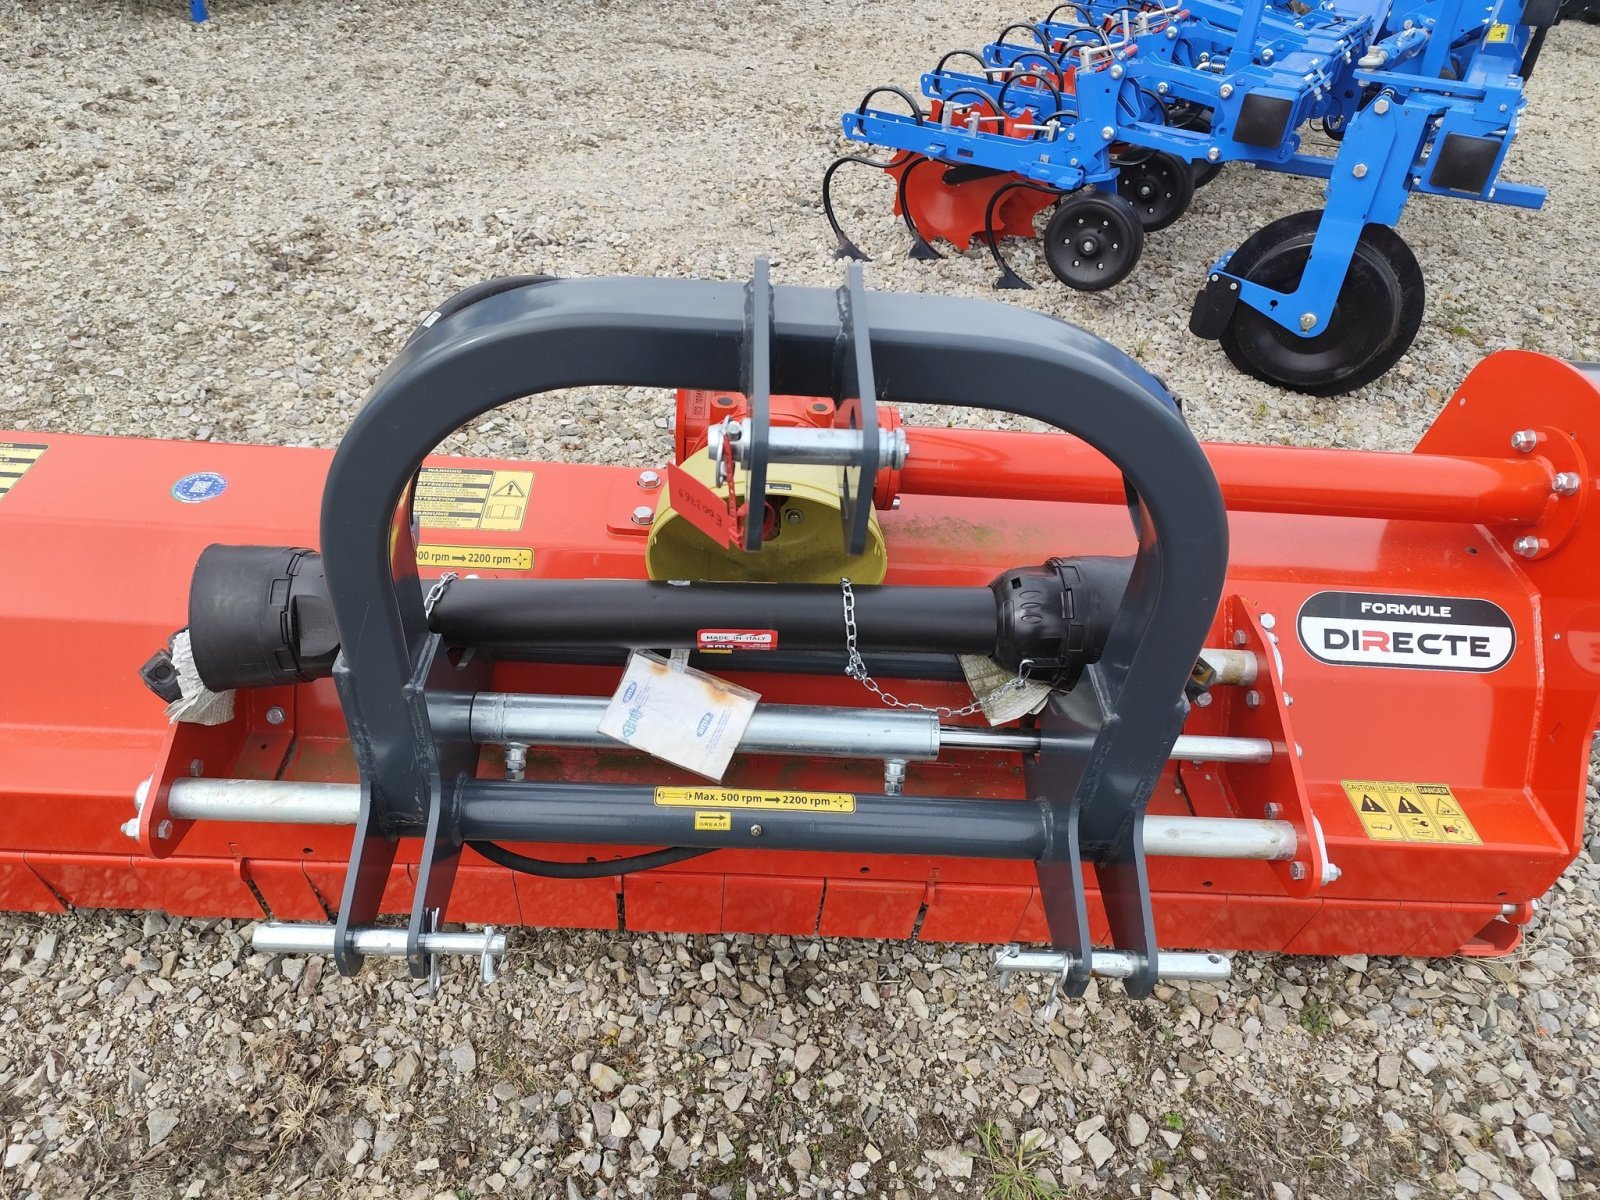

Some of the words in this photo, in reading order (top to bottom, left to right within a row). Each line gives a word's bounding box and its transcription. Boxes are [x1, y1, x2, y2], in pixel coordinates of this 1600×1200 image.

[431, 553, 450, 563] rpm
[468, 553, 490, 563] 2200
[492, 555, 511, 565] rpm
[1361, 602, 1452, 618] FORMULE
[1323, 628, 1491, 658] DIRECTE
[1417, 786, 1449, 794] DANGER
[694, 792, 718, 801] Max.
[721, 793, 739, 802] 500
[741, 795, 762, 804] rpm
[782, 796, 808, 805] 2200
[810, 797, 830, 806] rpm
